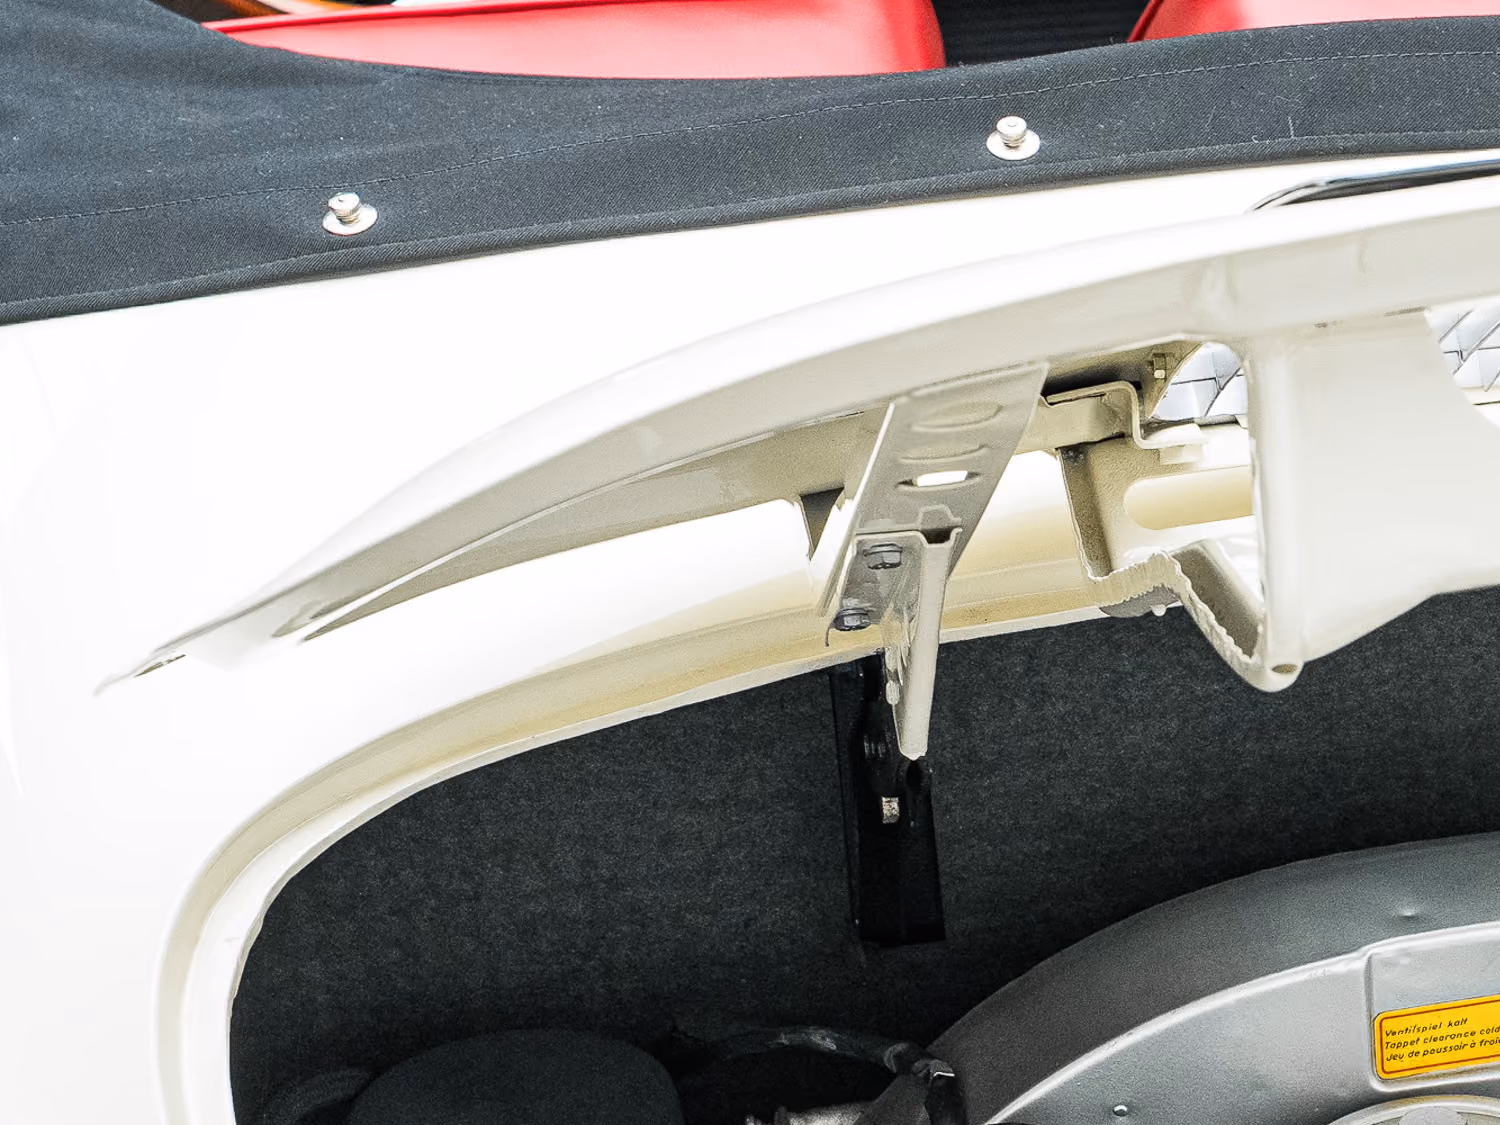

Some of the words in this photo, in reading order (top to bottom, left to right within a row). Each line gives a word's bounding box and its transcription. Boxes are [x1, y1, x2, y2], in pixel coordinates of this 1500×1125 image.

[1385, 1021, 1442, 1037] Ventilspiel
[1447, 1017, 1468, 1028] kalt
[1385, 1037, 1420, 1050] Tappet
[1423, 1030, 1477, 1044] clearance
[1408, 1049, 1421, 1058] de
[1422, 1041, 1468, 1057] poussoir
[1469, 1039, 1476, 1049] à
